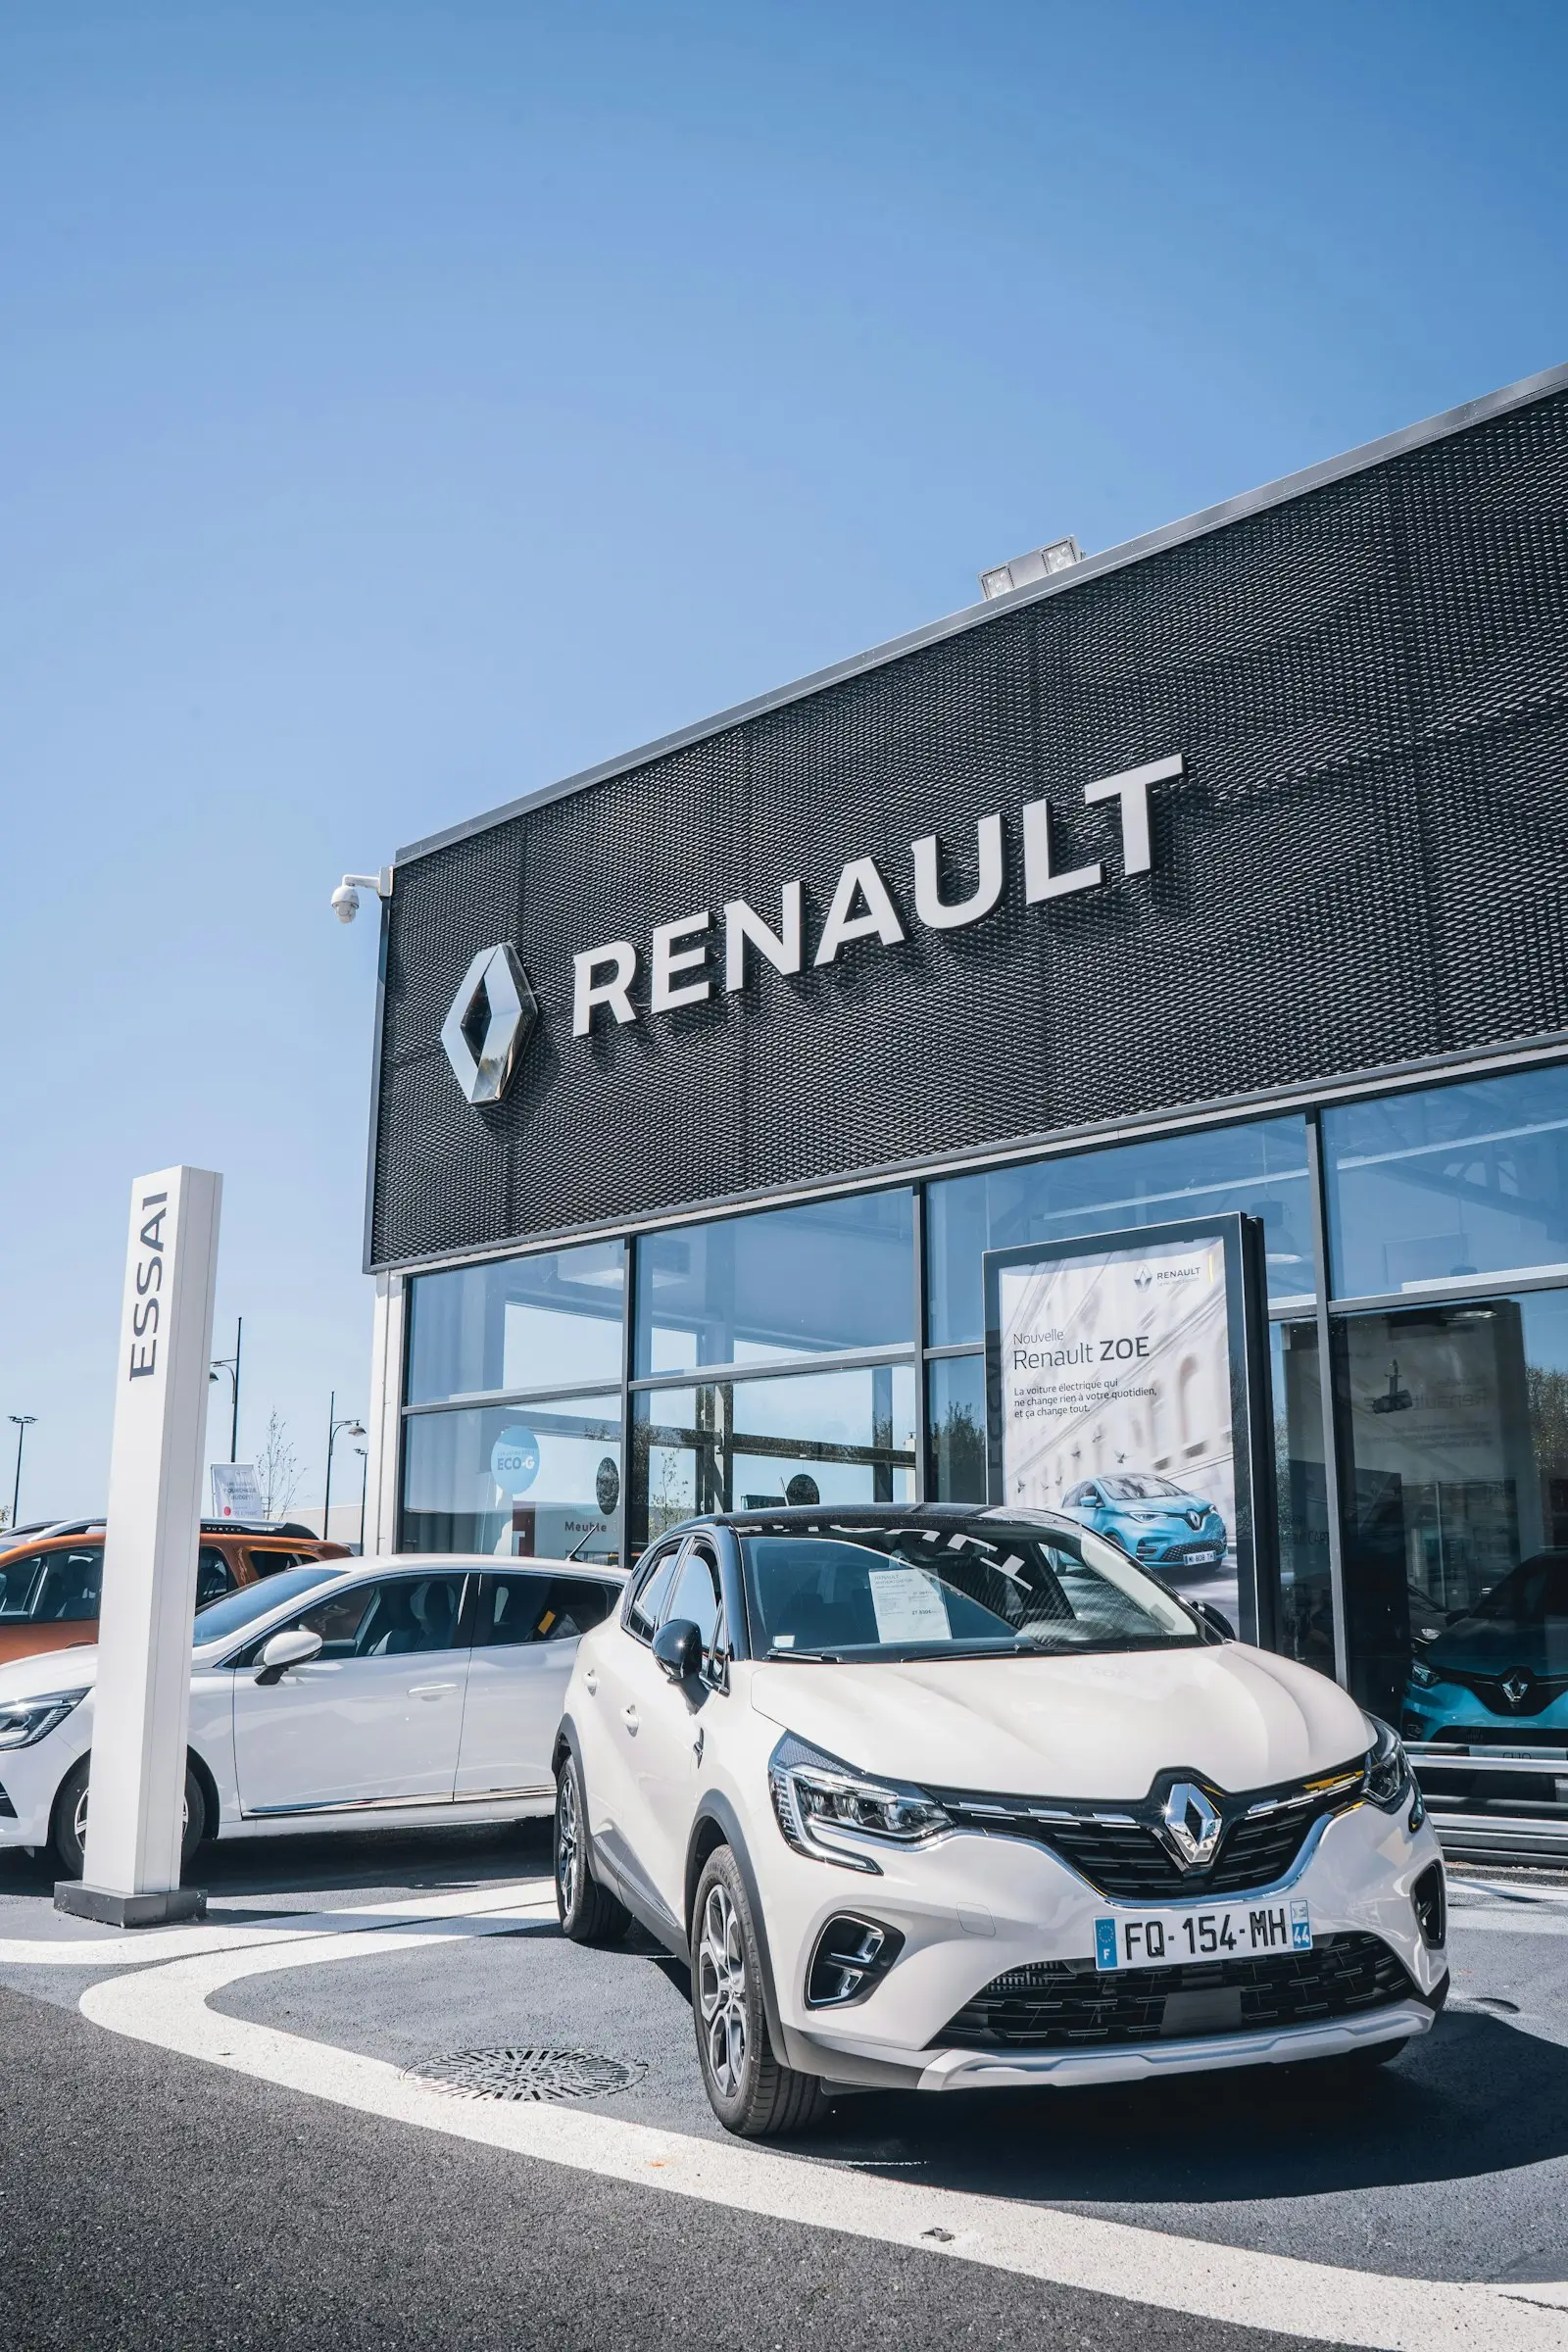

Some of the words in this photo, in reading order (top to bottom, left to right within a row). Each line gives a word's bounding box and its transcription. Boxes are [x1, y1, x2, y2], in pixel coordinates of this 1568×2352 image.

[572, 753, 1185, 1038] RENAULT
[1157, 1267, 1200, 1279] RENAULT
[129, 1192, 168, 1382] ESSAI
[1013, 1329, 1064, 1345] Nouvelle
[1013, 1343, 1094, 1370] Renault
[1100, 1336, 1150, 1361] ZOE
[1027, 1386, 1056, 1395] voiture
[1058, 1380, 1102, 1392] électrique
[1103, 1379, 1118, 1389] qui
[1027, 1396, 1057, 1407] change
[1059, 1395, 1076, 1403] rien
[1079, 1393, 1084, 1401] à
[1086, 1392, 1109, 1400] votre
[1111, 1388, 1157, 1398] quotidien,
[1014, 1409, 1024, 1418] et
[1025, 1410, 1035, 1420] ça
[1037, 1406, 1068, 1417] change
[1069, 1404, 1090, 1413] tout.
[497, 1455, 535, 1470] ECO-G
[1124, 1908, 1287, 1960] FQ-154-MH
[1294, 1926, 1309, 1943] 44
[1102, 1948, 1110, 1960] F
